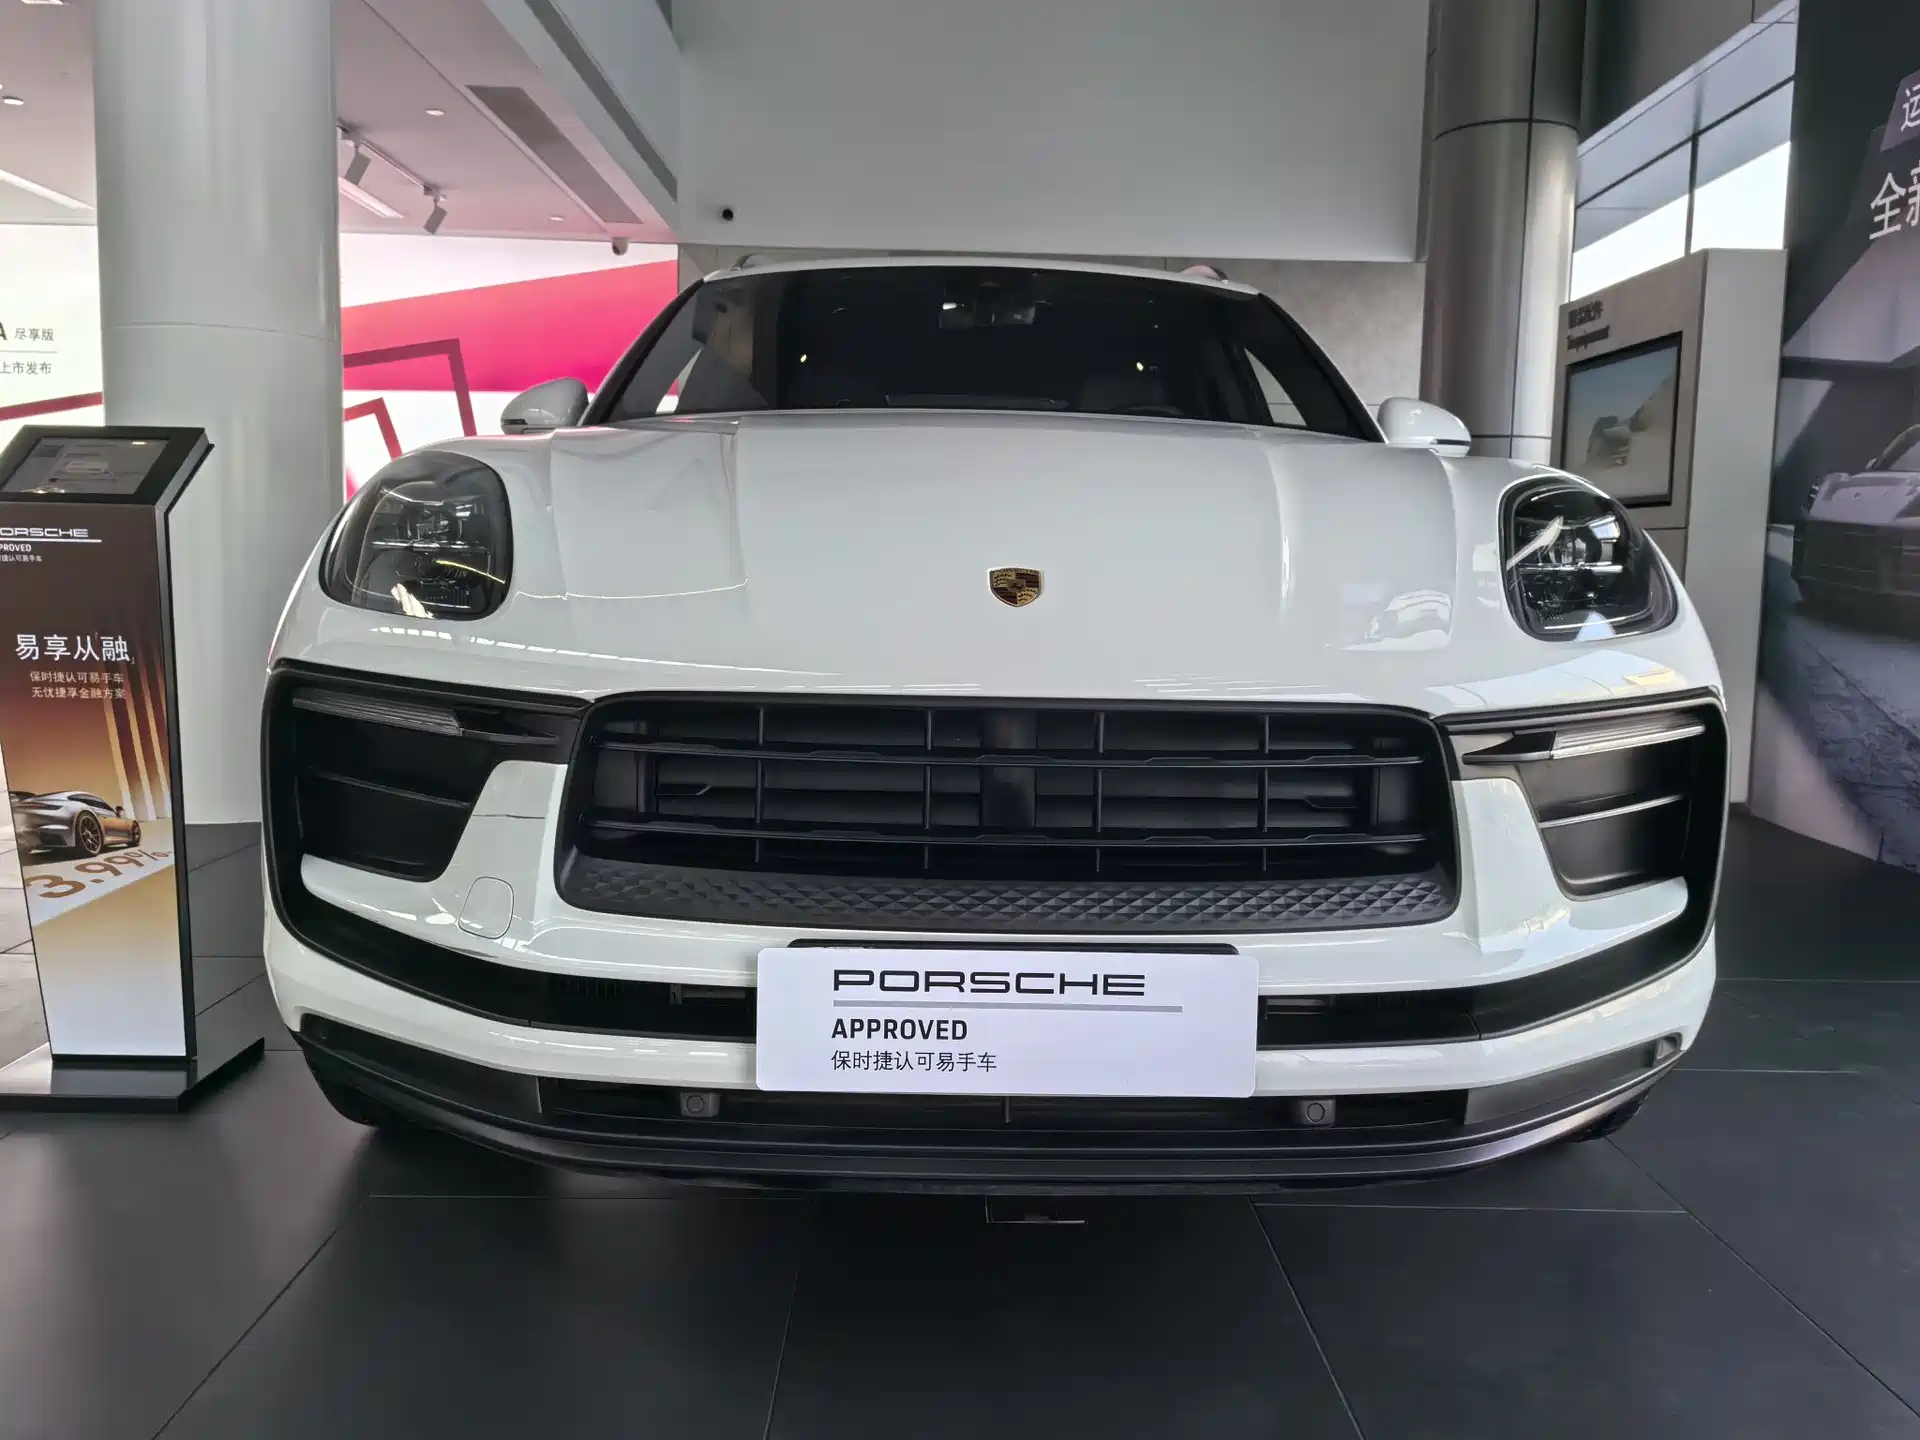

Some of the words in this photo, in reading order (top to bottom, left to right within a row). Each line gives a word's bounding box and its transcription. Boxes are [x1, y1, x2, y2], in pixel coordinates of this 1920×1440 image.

[14, 327, 55, 342] 尽享版
[0, 361, 52, 375] 上市发布
[30, 671, 125, 684] 保时捷认可易手车
[32, 686, 127, 699] 无忧捷享金融方案
[833, 969, 1146, 997] PORSCHE
[831, 1018, 968, 1041] APPROVED
[831, 1049, 998, 1073] 保时捷认可易手车
